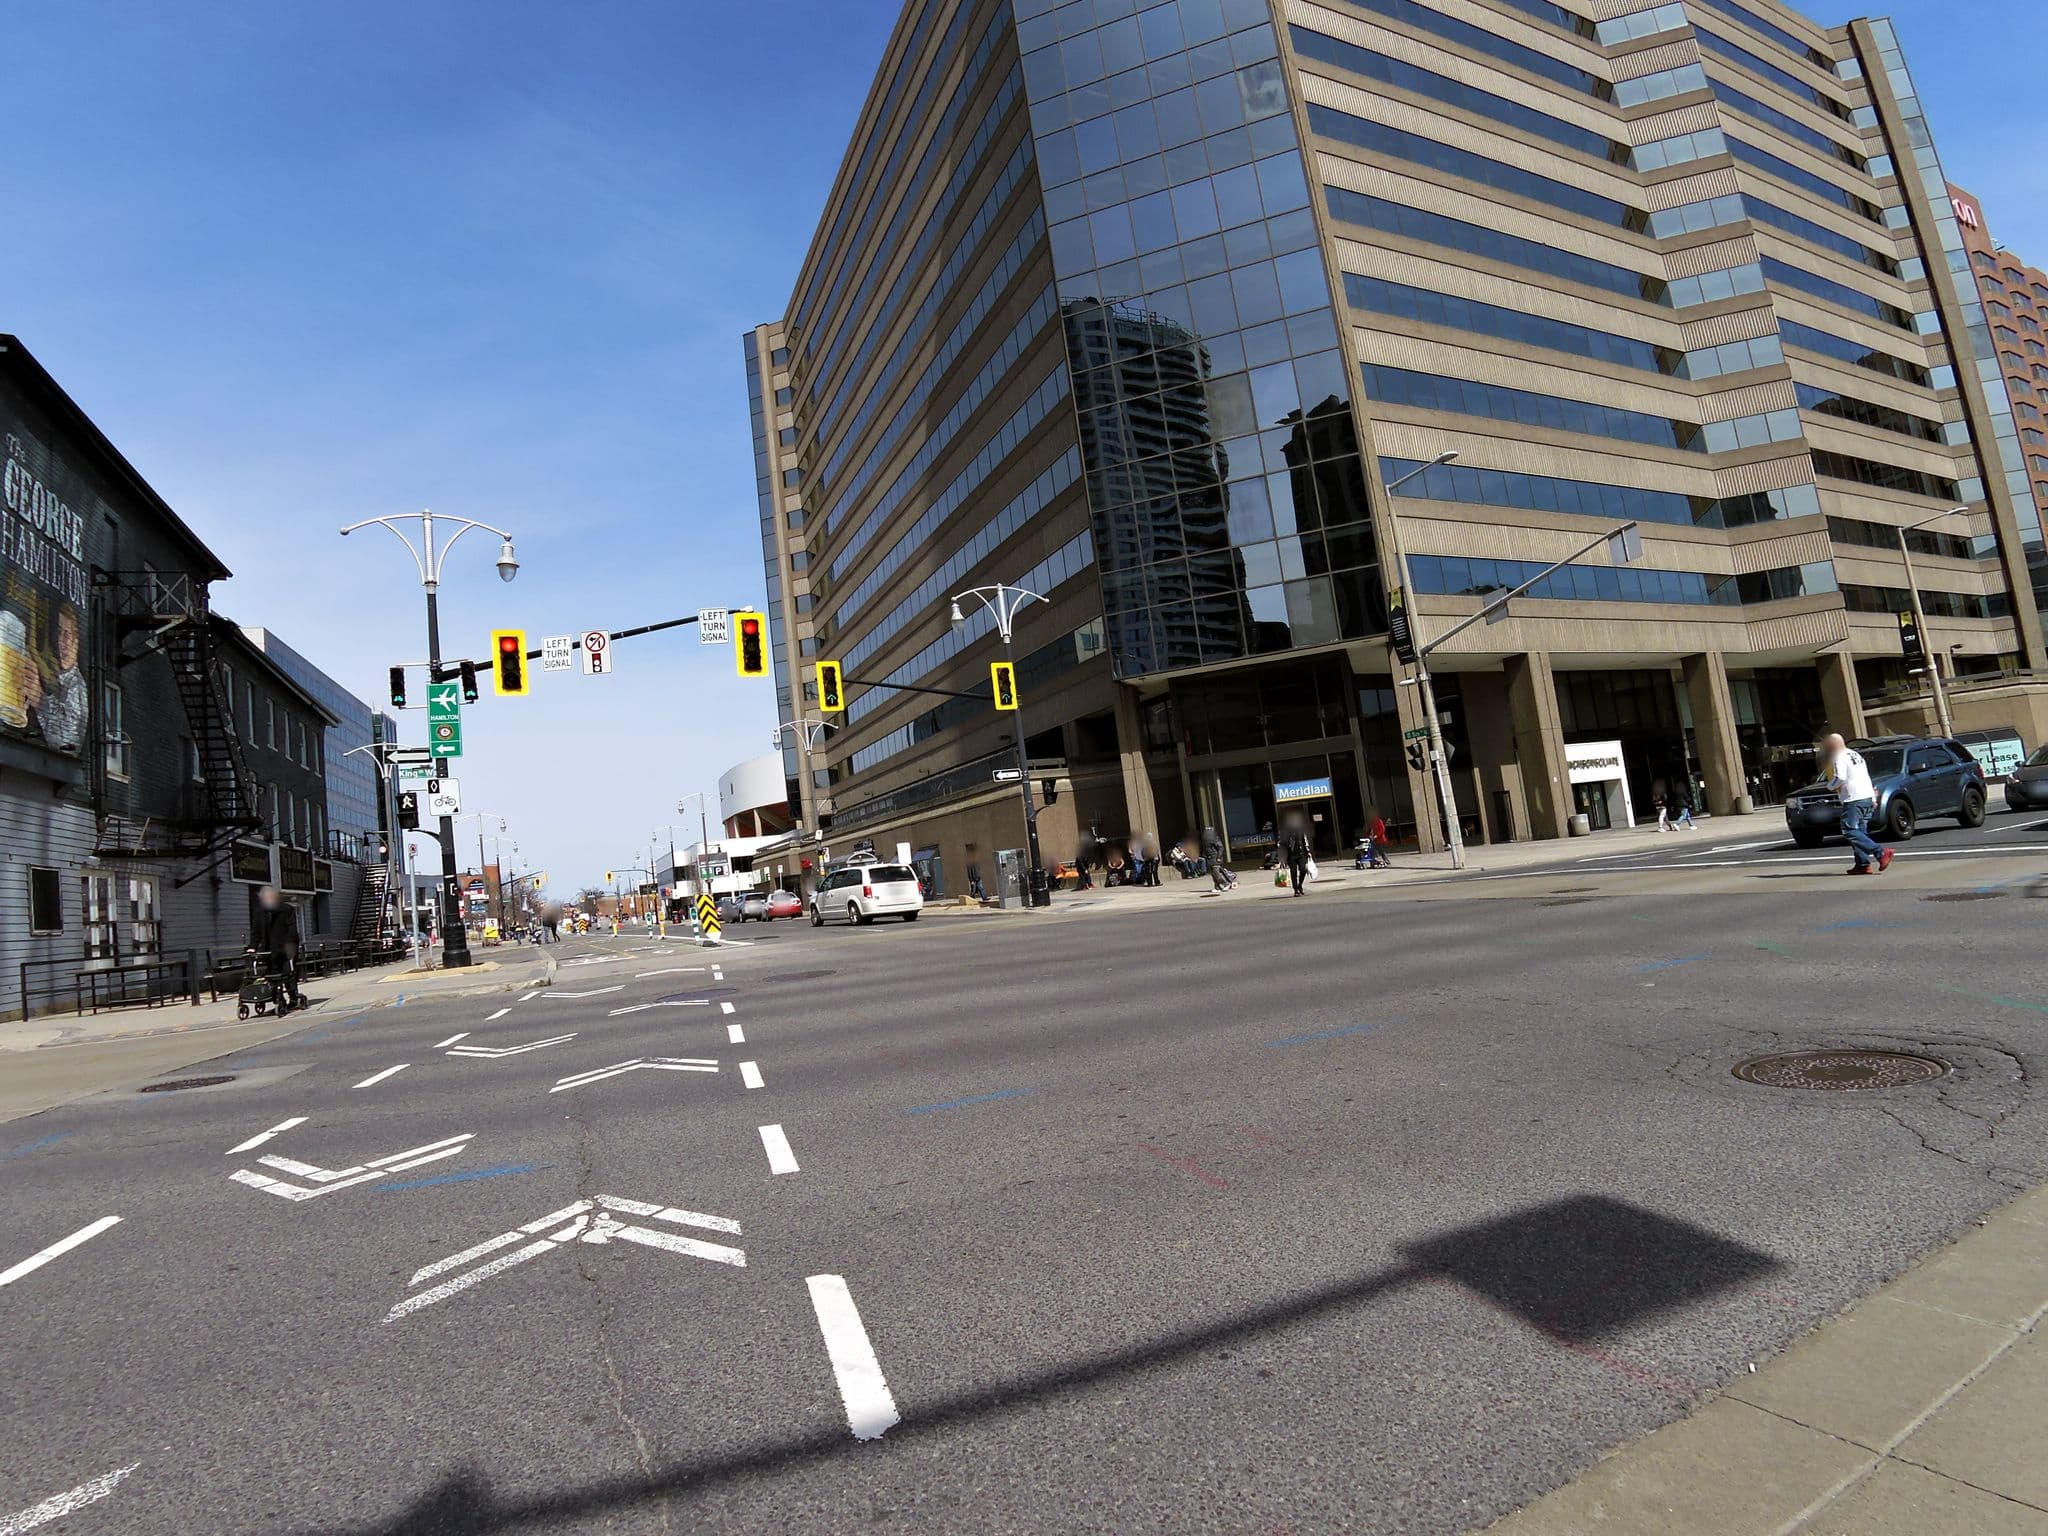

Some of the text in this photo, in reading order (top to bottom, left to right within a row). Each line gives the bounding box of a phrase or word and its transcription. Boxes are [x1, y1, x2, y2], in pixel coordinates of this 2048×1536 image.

[4, 458, 83, 563] GEORGE
[1, 510, 86, 609] HAMILTON
[703, 611, 725, 621] LEFT
[703, 621, 726, 631] TURN
[702, 632, 728, 642] SIGNAL
[546, 638, 567, 648] LEFT
[546, 649, 569, 659] TURN
[545, 659, 571, 669] SIGNAL
[1986, 753, 2018, 763] Lease
[400, 768, 418, 778] King
[1279, 785, 1328, 798] Meridian
